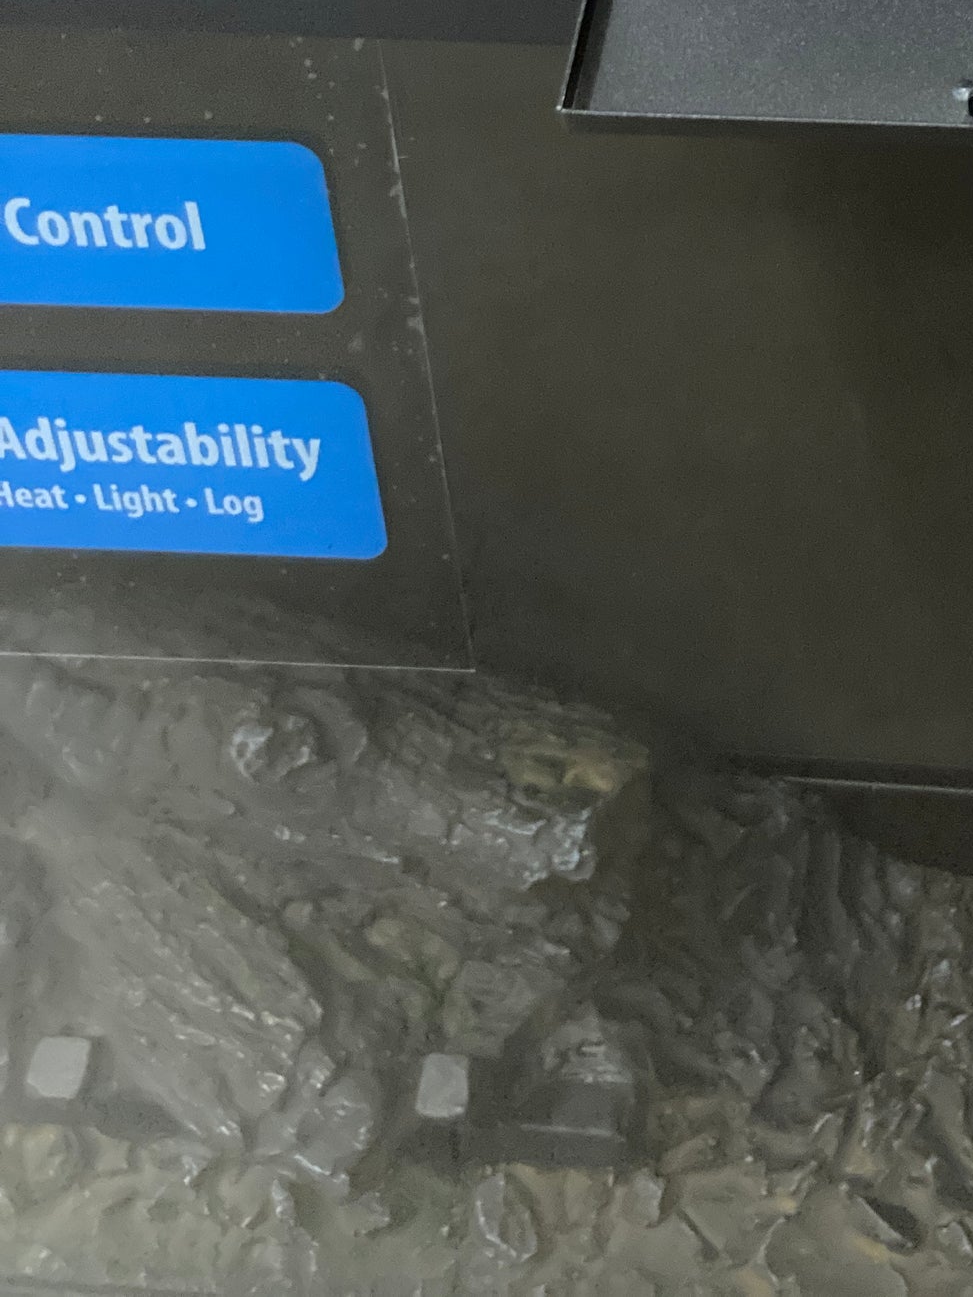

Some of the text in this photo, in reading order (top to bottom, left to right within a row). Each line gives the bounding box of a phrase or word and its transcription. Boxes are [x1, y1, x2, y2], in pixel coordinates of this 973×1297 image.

[3, 197, 206, 251] Control
[0, 416, 321, 482] Adjustability
[93, 483, 181, 518] Light
[205, 488, 265, 523] Log
